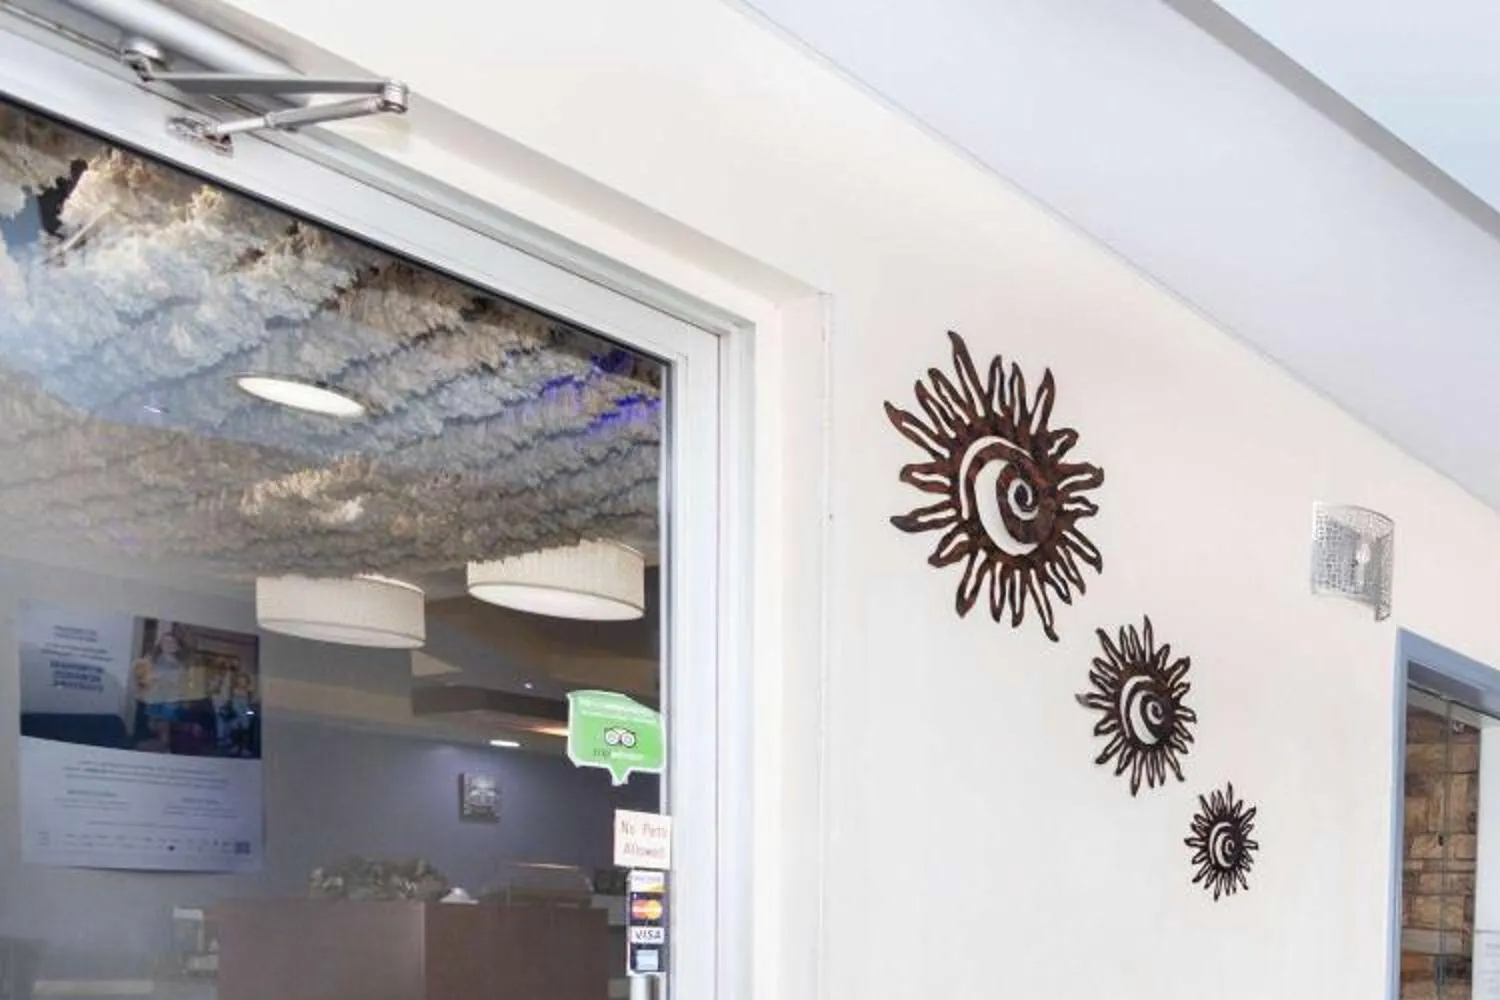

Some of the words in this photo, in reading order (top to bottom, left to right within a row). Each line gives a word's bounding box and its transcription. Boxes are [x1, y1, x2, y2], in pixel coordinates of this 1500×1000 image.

[621, 820, 636, 836] No
[642, 823, 668, 838] Pets
[623, 842, 666, 859] Allowed
[635, 928, 662, 940] VISA
